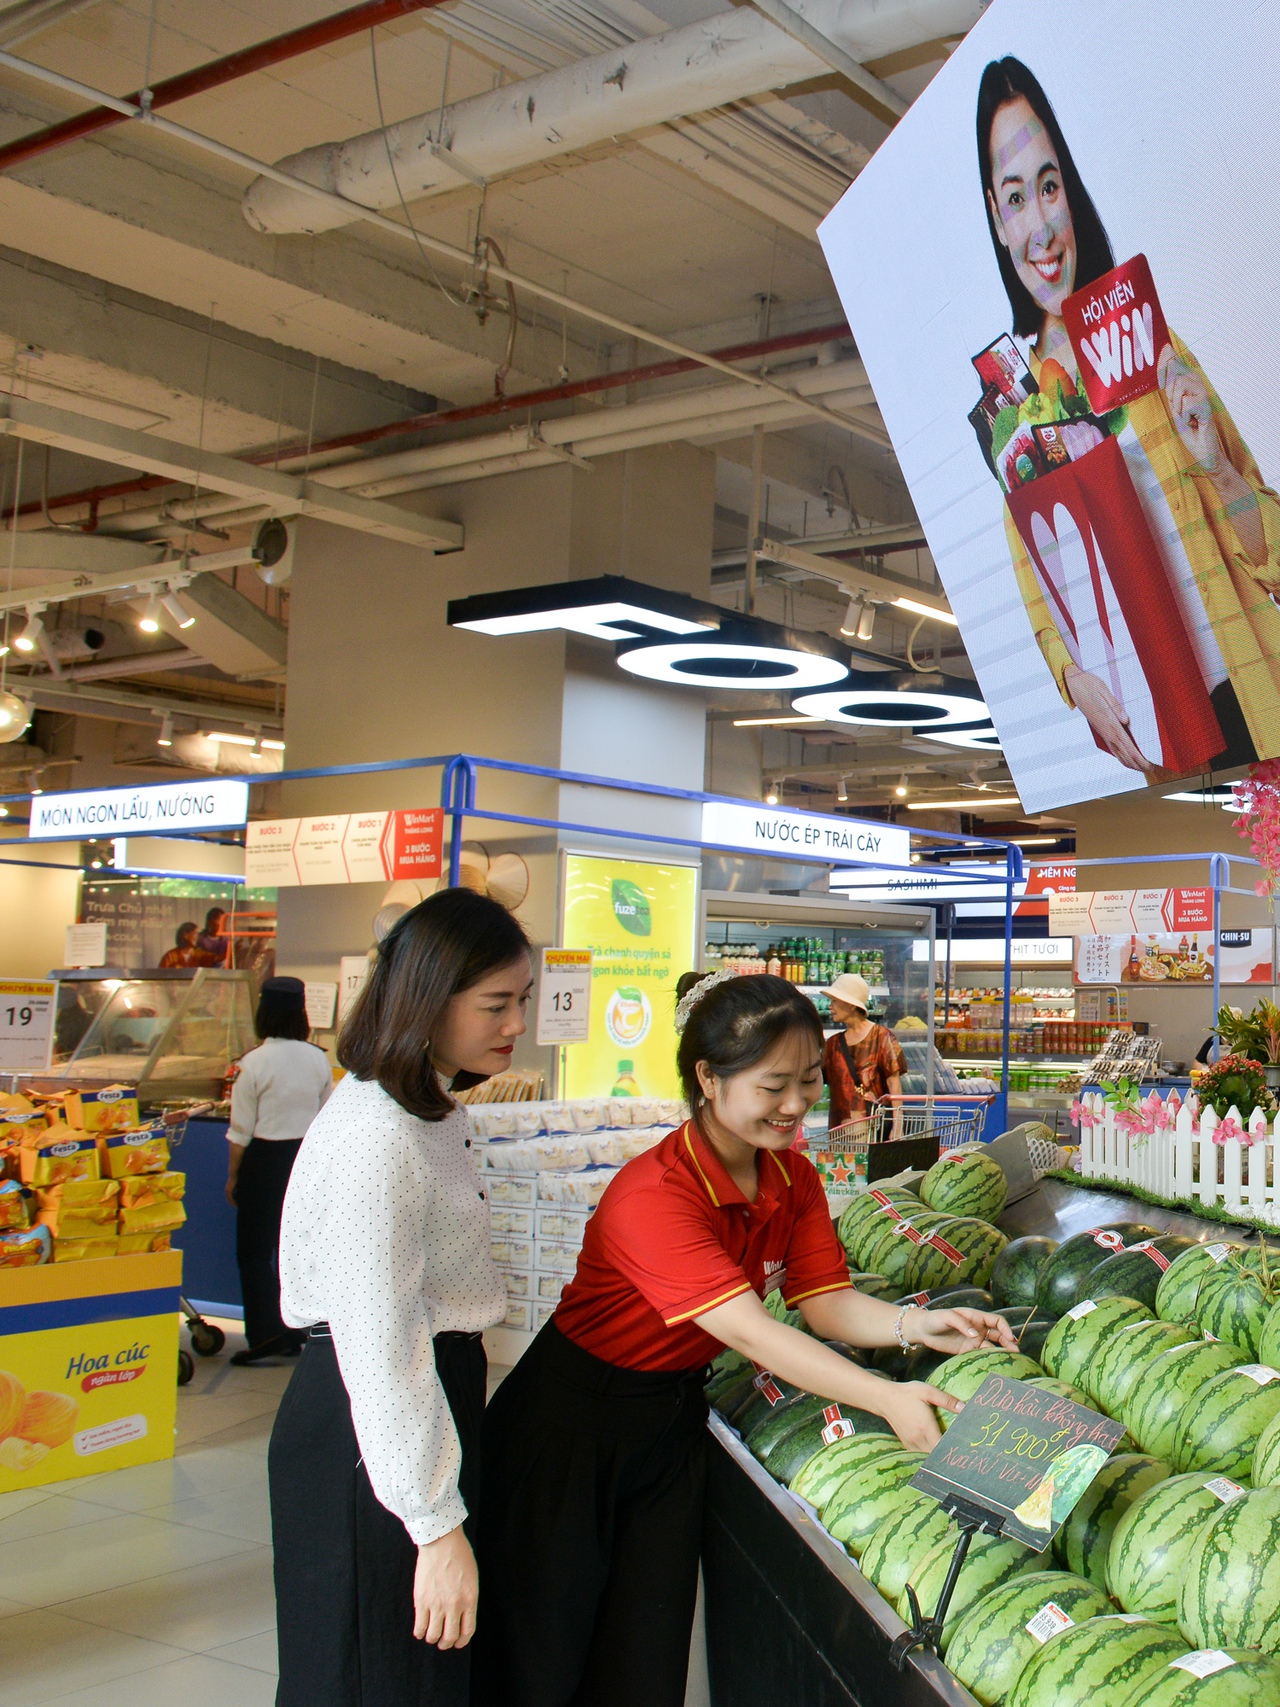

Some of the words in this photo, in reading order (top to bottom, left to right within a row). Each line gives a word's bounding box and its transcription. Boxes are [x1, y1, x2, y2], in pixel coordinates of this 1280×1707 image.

[1080, 295, 1104, 326] HỘI
[1103, 279, 1135, 312] VIÊN
[40, 804, 72, 827] MÓN
[76, 803, 118, 824] NGON
[156, 792, 215, 818] NƯỚNG
[403, 813, 435, 826] WinMart
[755, 819, 800, 843] NƯỚC
[804, 826, 821, 846] ÉP
[824, 829, 853, 850] TRÁI
[857, 831, 882, 853] CÂY
[405, 845, 410, 854] 3
[399, 856, 414, 865] MUA
[415, 853, 436, 864] HÀNG
[1180, 889, 1206, 899] WinMart
[1220, 932, 1250, 941] CHIN-SU
[604, 947, 631, 958] chanh
[633, 948, 660, 960] quyện
[1010, 944, 1029, 956] HỊT
[1033, 942, 1059, 955] TƯƠI
[592, 966, 610, 978] gon
[347, 975, 358, 989] 17
[552, 991, 572, 1011] 13
[6, 1006, 33, 1026] 19
[100, 1091, 121, 1099] Festa
[126, 1132, 150, 1142] Festa
[53, 1144, 77, 1154] Festa
[66, 1353, 109, 1379] Hoa
[115, 1342, 151, 1365] cúc
